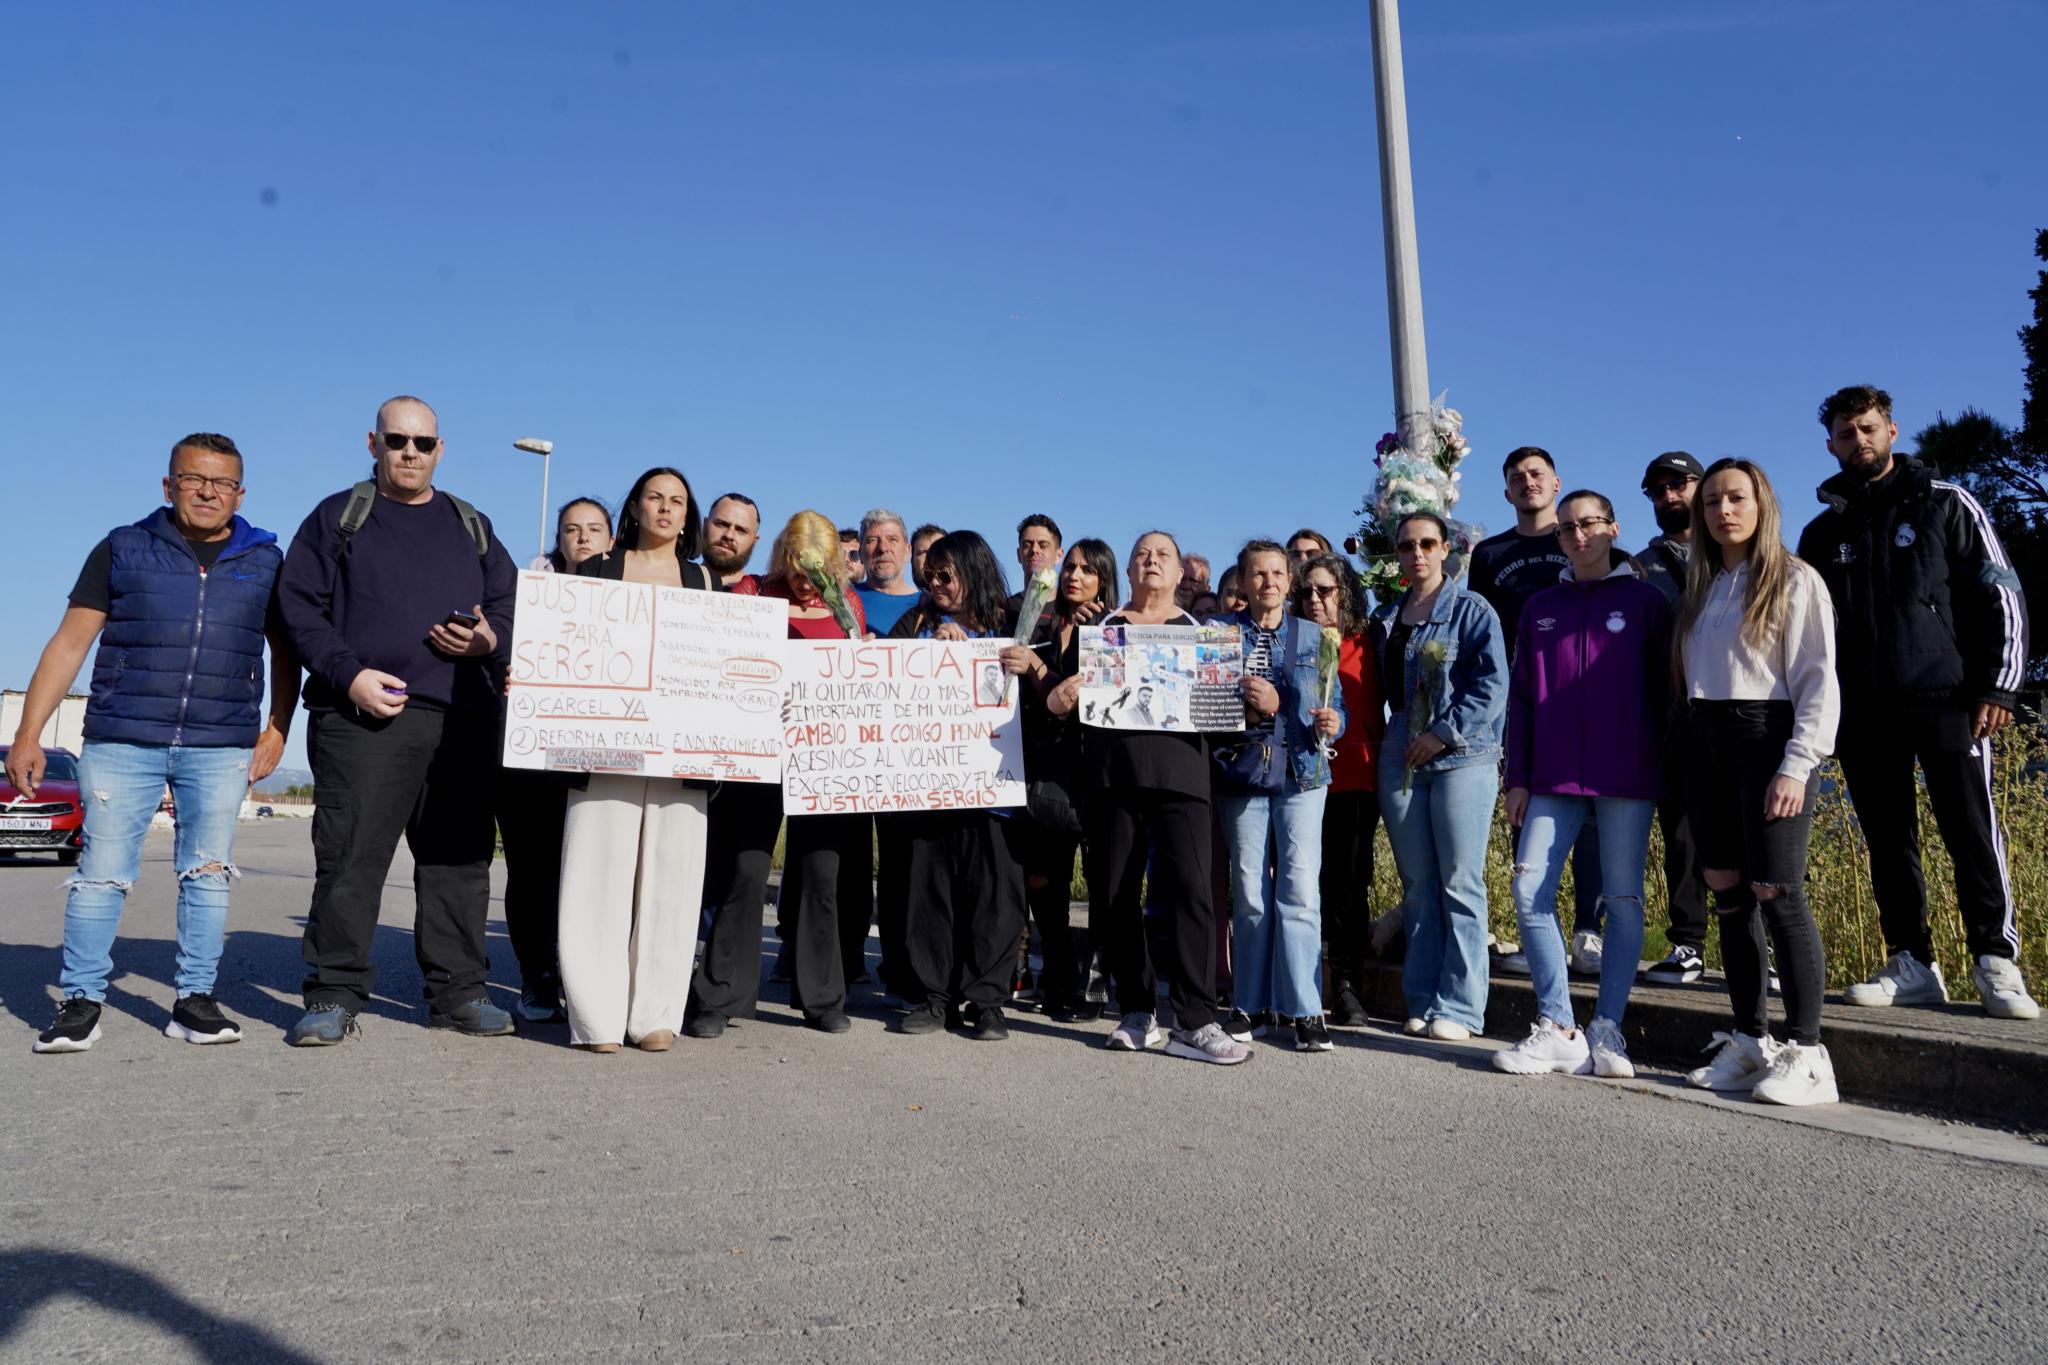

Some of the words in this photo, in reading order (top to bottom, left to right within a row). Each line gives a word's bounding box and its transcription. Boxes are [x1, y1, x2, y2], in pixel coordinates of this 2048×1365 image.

[1494, 558, 1525, 587] PEDRO
[1545, 553, 1573, 567] HIER
[524, 575, 650, 625] JUSTICIA
[704, 595, 716, 606] DE
[719, 597, 774, 614] VELOCIDAD
[560, 621, 613, 649] PARA
[1128, 632, 1153, 640] JUSTICIA
[1154, 632, 1170, 640] PARA
[515, 639, 633, 685] SERGIO
[813, 643, 964, 680] JUSTICIA
[661, 674, 710, 689] HOMICIDIO
[718, 680, 736, 690] POR
[790, 681, 809, 702] ME
[815, 681, 901, 702] QUITARON
[910, 683, 930, 701] LO
[656, 686, 735, 703] IMPRUDENCIA
[620, 696, 647, 718] YA
[791, 703, 883, 722] IMPORTANTE
[894, 704, 913, 718] DE
[918, 703, 934, 717] MI
[938, 704, 974, 717] VIDA
[539, 729, 607, 748] REFORMA
[615, 730, 664, 748] PENAL
[673, 733, 783, 756] ENDURECIMIENTO
[786, 722, 847, 749] CAMBIO
[859, 722, 884, 744] DEL
[950, 721, 1001, 742] PENAL
[555, 757, 587, 766] JUSTICIA
[588, 759, 608, 767] PARA
[609, 759, 637, 768] SERGIO
[786, 747, 867, 774] ASESINOS
[873, 745, 895, 768] AL
[901, 744, 969, 768] VOLANTE
[725, 766, 758, 777] PENAL
[788, 774, 861, 798] EXCESO
[865, 774, 883, 793] DE
[887, 771, 960, 794] VELOCIDAD
[959, 771, 972, 790] Y
[975, 769, 1018, 790] FUGA
[801, 794, 894, 813] JUSTICIA
[894, 793, 926, 811] PARA
[927, 789, 998, 810] SERGIO
[1, 820, 26, 829] 1503
[28, 821, 49, 829] MNJ
